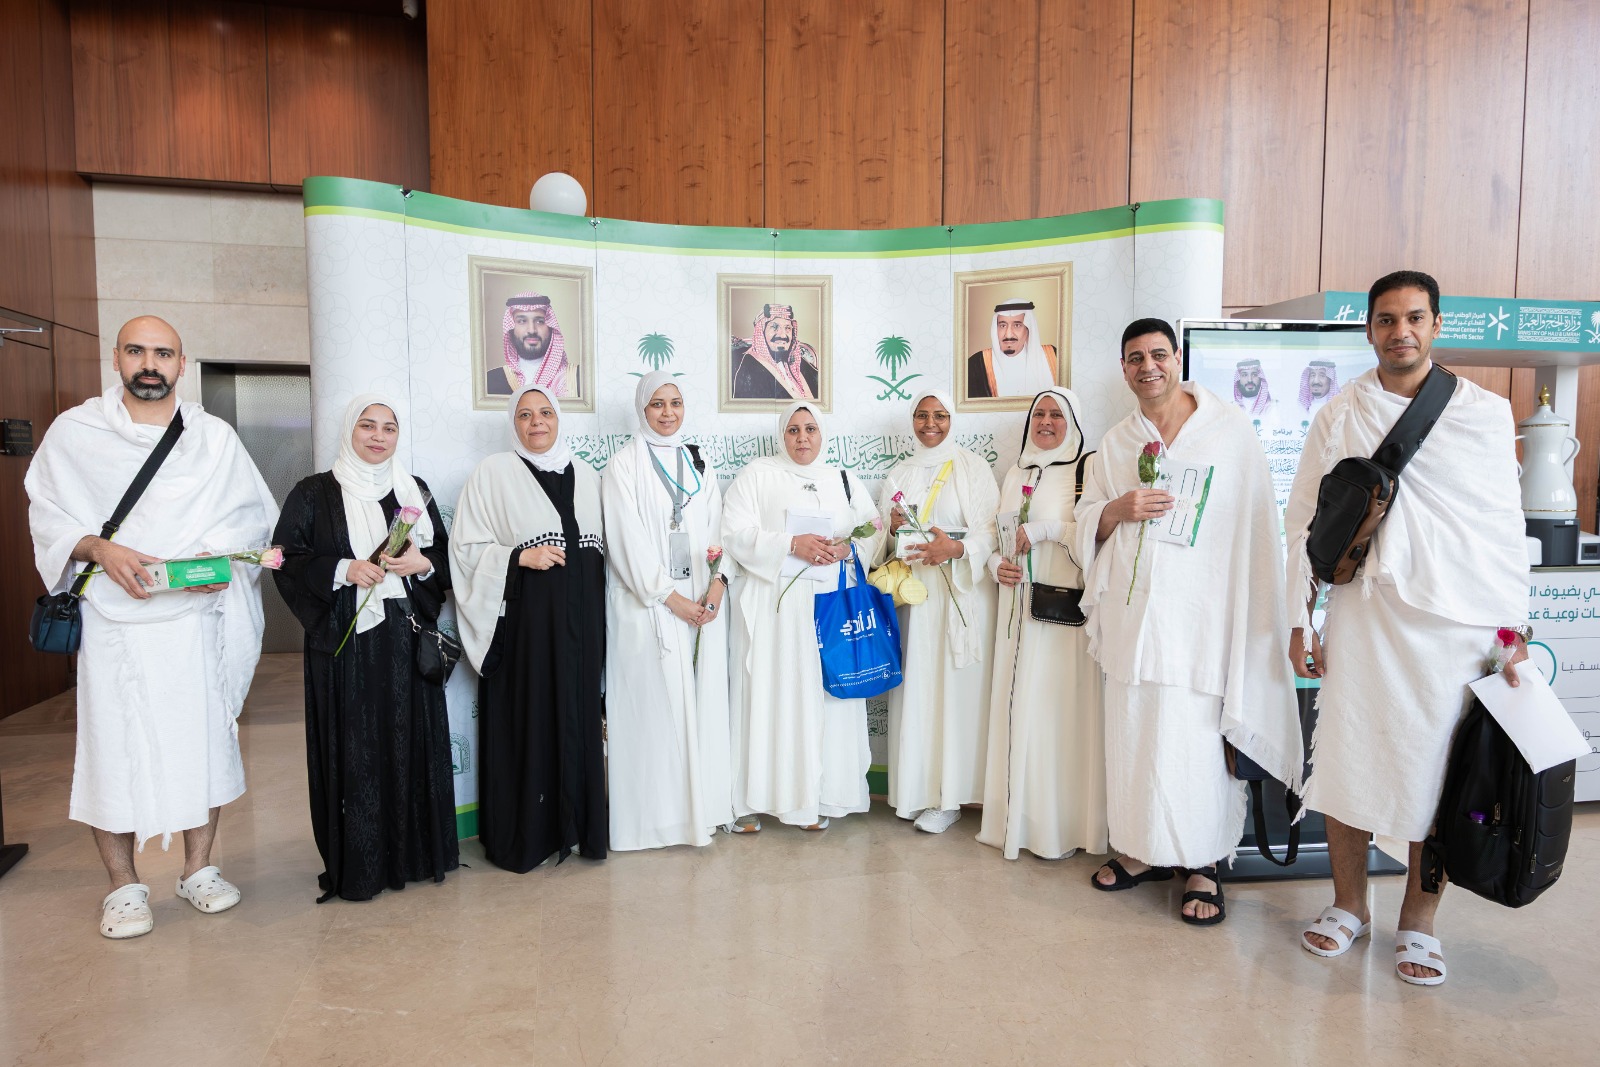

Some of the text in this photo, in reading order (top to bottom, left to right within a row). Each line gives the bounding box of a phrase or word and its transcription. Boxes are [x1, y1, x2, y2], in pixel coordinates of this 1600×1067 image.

[842, 435, 898, 471] الحرمين
[1540, 585, 1581, 600] بضيوف
[1543, 607, 1579, 623] نوعية
